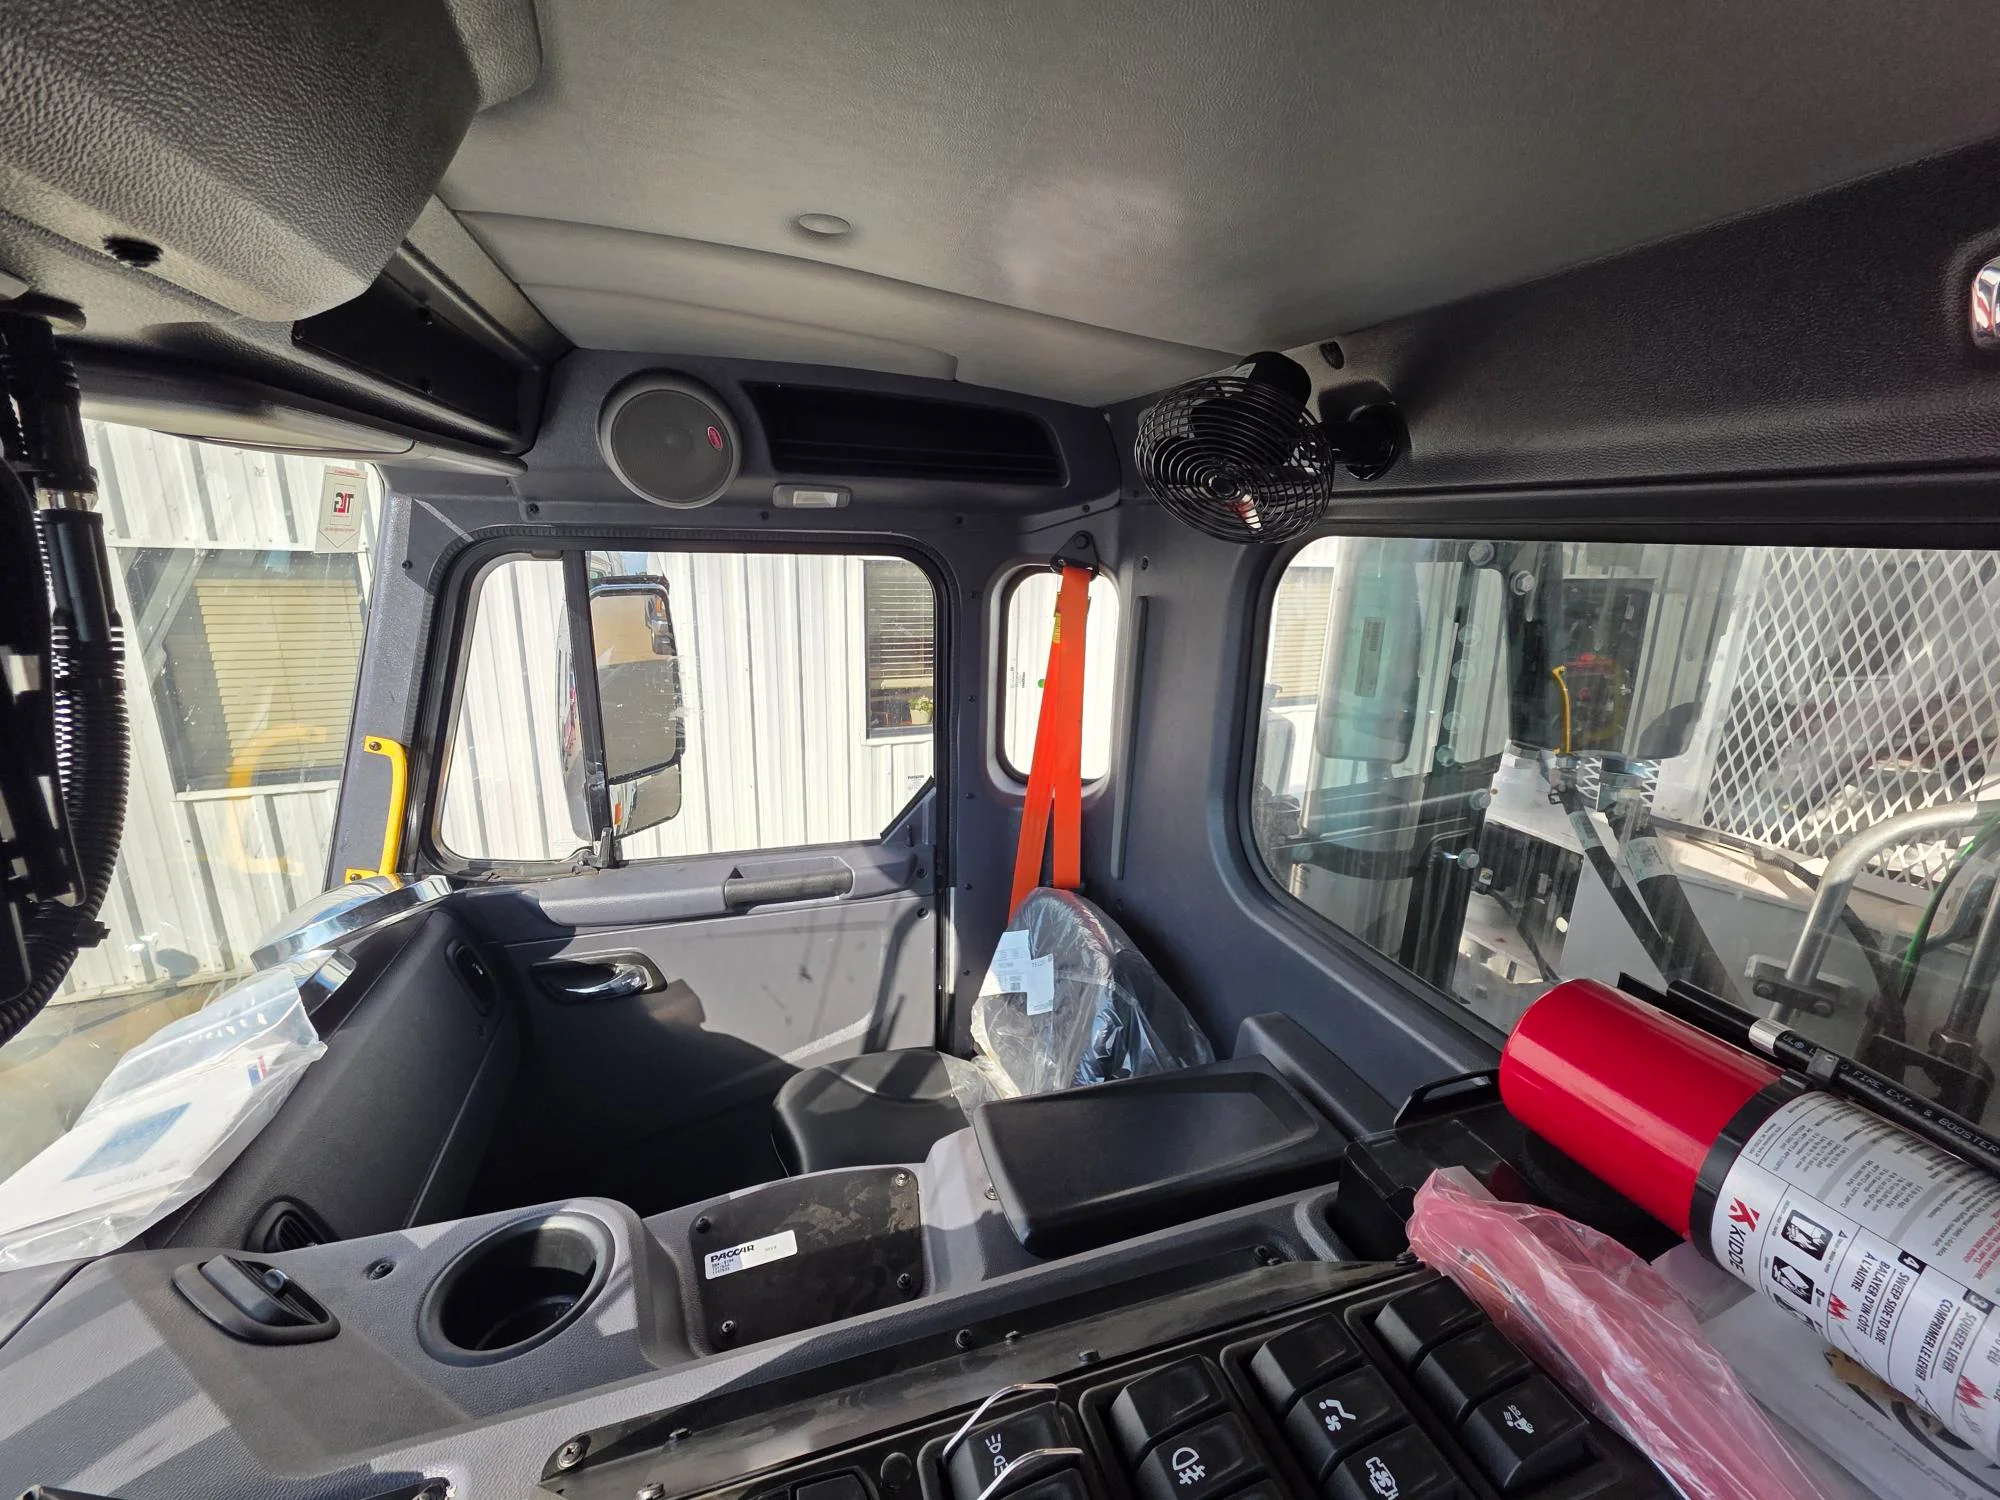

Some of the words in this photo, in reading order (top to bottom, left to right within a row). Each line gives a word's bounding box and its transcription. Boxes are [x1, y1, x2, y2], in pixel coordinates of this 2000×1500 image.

[1852, 1070, 1883, 1089] FIRE
[1885, 1088, 1911, 1107] EXT.
[1937, 1117, 2000, 1152] BOOSTER
[710, 1245, 755, 1262] PACCAR
[1729, 1224, 1745, 1275] KIDDE
[1864, 1252, 1876, 1262] À
[1901, 1254, 1918, 1268] 4
[1850, 1259, 1872, 1292] L'AUTRE
[1865, 1260, 1890, 1298] BALAYER
[1888, 1271, 1910, 1301] SWEEP
[1859, 1294, 1876, 1317] D'UN
[1880, 1298, 1898, 1320] SIDE
[1856, 1313, 1870, 1334] CÔTÉ
[1877, 1314, 1891, 1329] TO
[1922, 1298, 1954, 1349] COMPRIMER
[1952, 1311, 1977, 1350] SQUEEZE
[1873, 1325, 1887, 1345] SIDE
[1918, 1345, 1933, 1359] LE
[1941, 1348, 1959, 1374] LEVER
[1912, 1354, 1930, 1381] LEVIER
